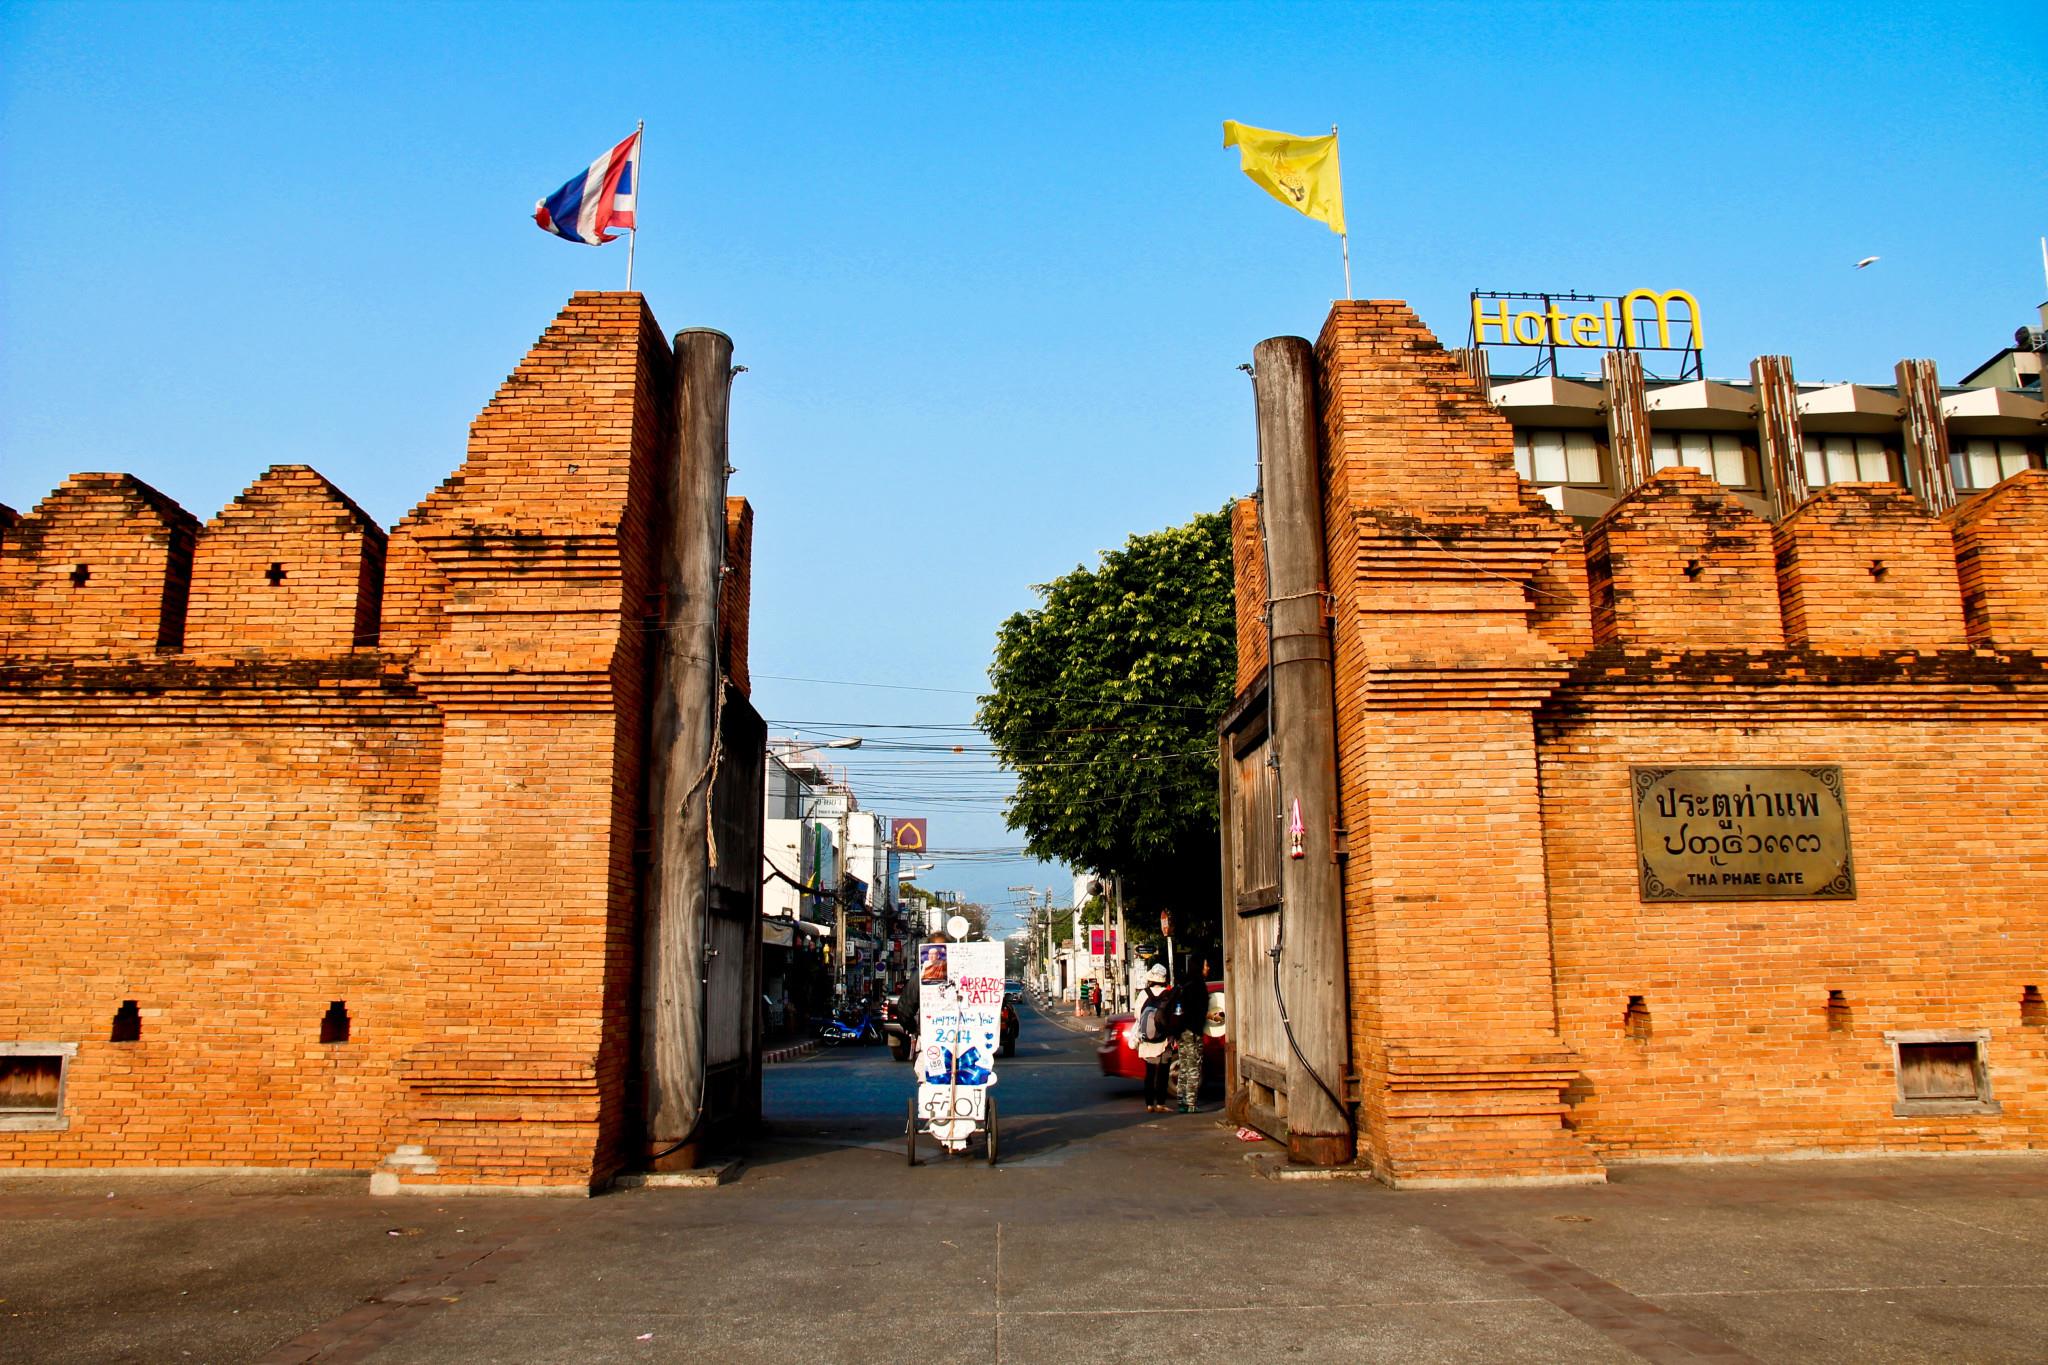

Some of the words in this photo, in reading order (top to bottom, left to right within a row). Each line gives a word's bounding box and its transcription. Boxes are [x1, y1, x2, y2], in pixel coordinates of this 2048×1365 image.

[1473, 298, 1616, 347] Hotel
[1656, 784, 1820, 830] ประตูท่าแพ
[1687, 873, 1718, 886] THA
[1722, 873, 1761, 886] PHAE
[1766, 872, 1804, 885] GATE
[936, 1029, 971, 1043] 2014
